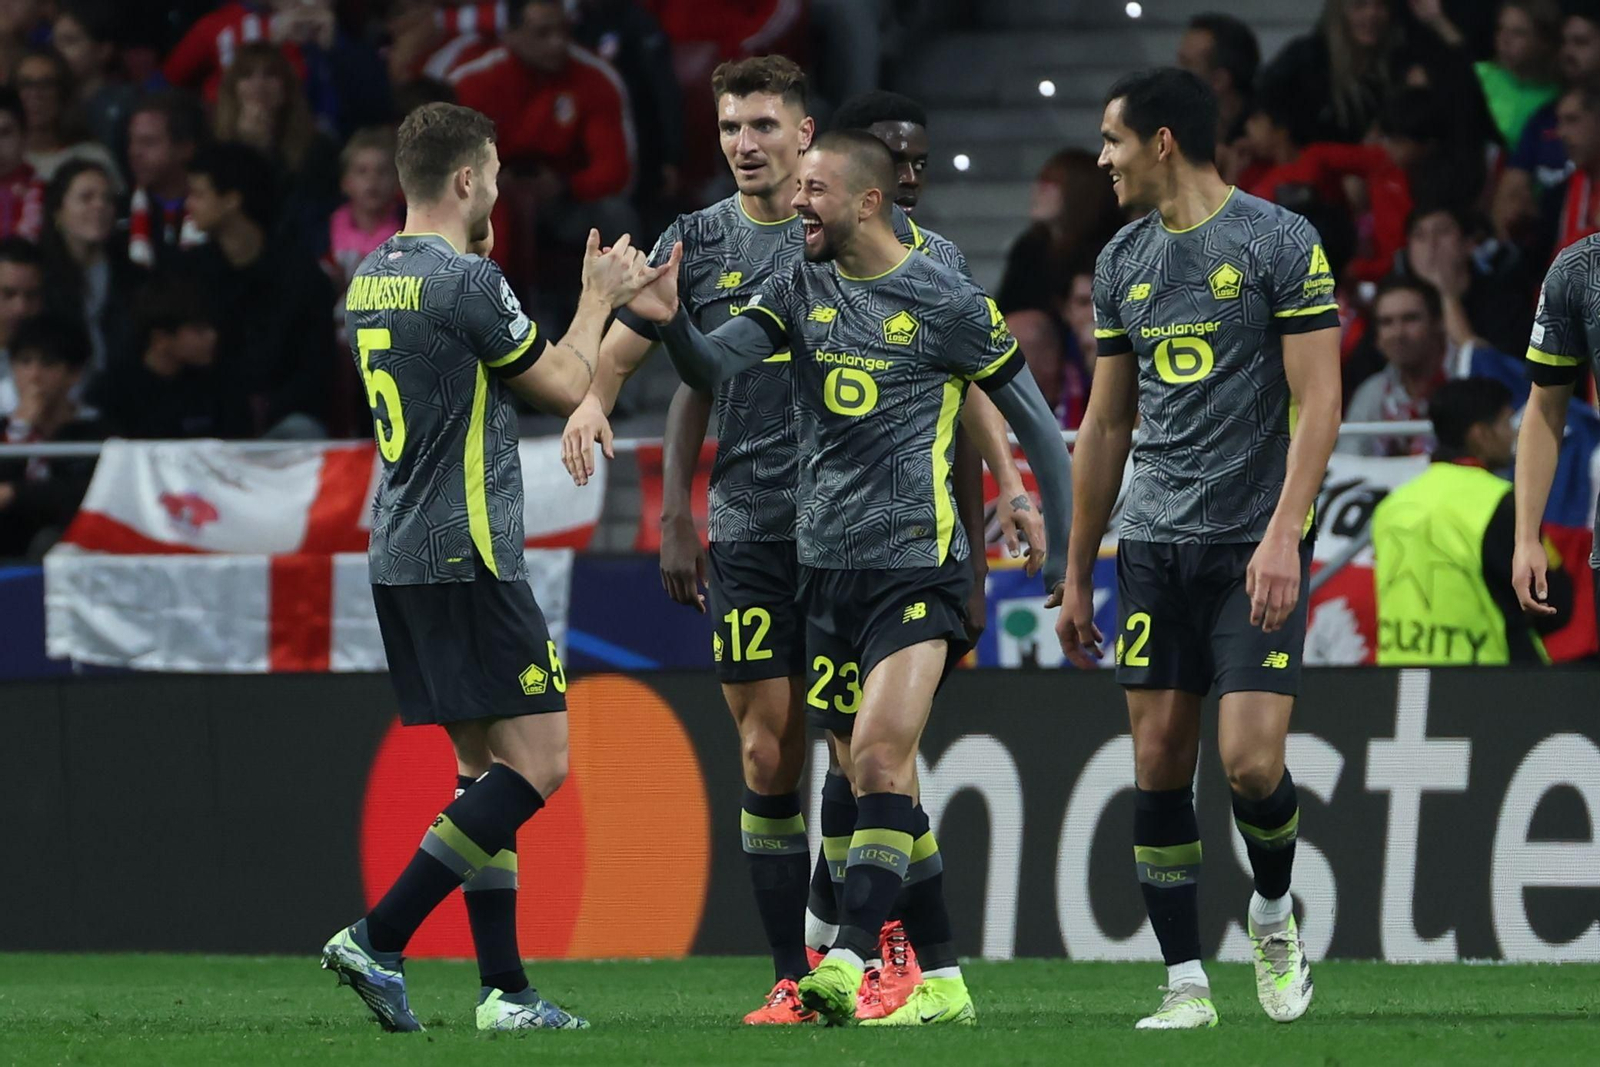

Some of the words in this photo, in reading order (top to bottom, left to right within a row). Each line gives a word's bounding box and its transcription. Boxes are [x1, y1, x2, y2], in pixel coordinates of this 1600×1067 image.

[1141, 320, 1221, 338] boulanger
[815, 349, 893, 371] boulanger
[356, 328, 406, 463] 5
[723, 606, 773, 662] 12
[1125, 612, 1151, 667] 2
[546, 639, 567, 693] 5
[806, 655, 863, 714] 23
[746, 836, 789, 850] LOSC
[859, 848, 900, 867] LOSC
[1146, 867, 1187, 882] LOSC
